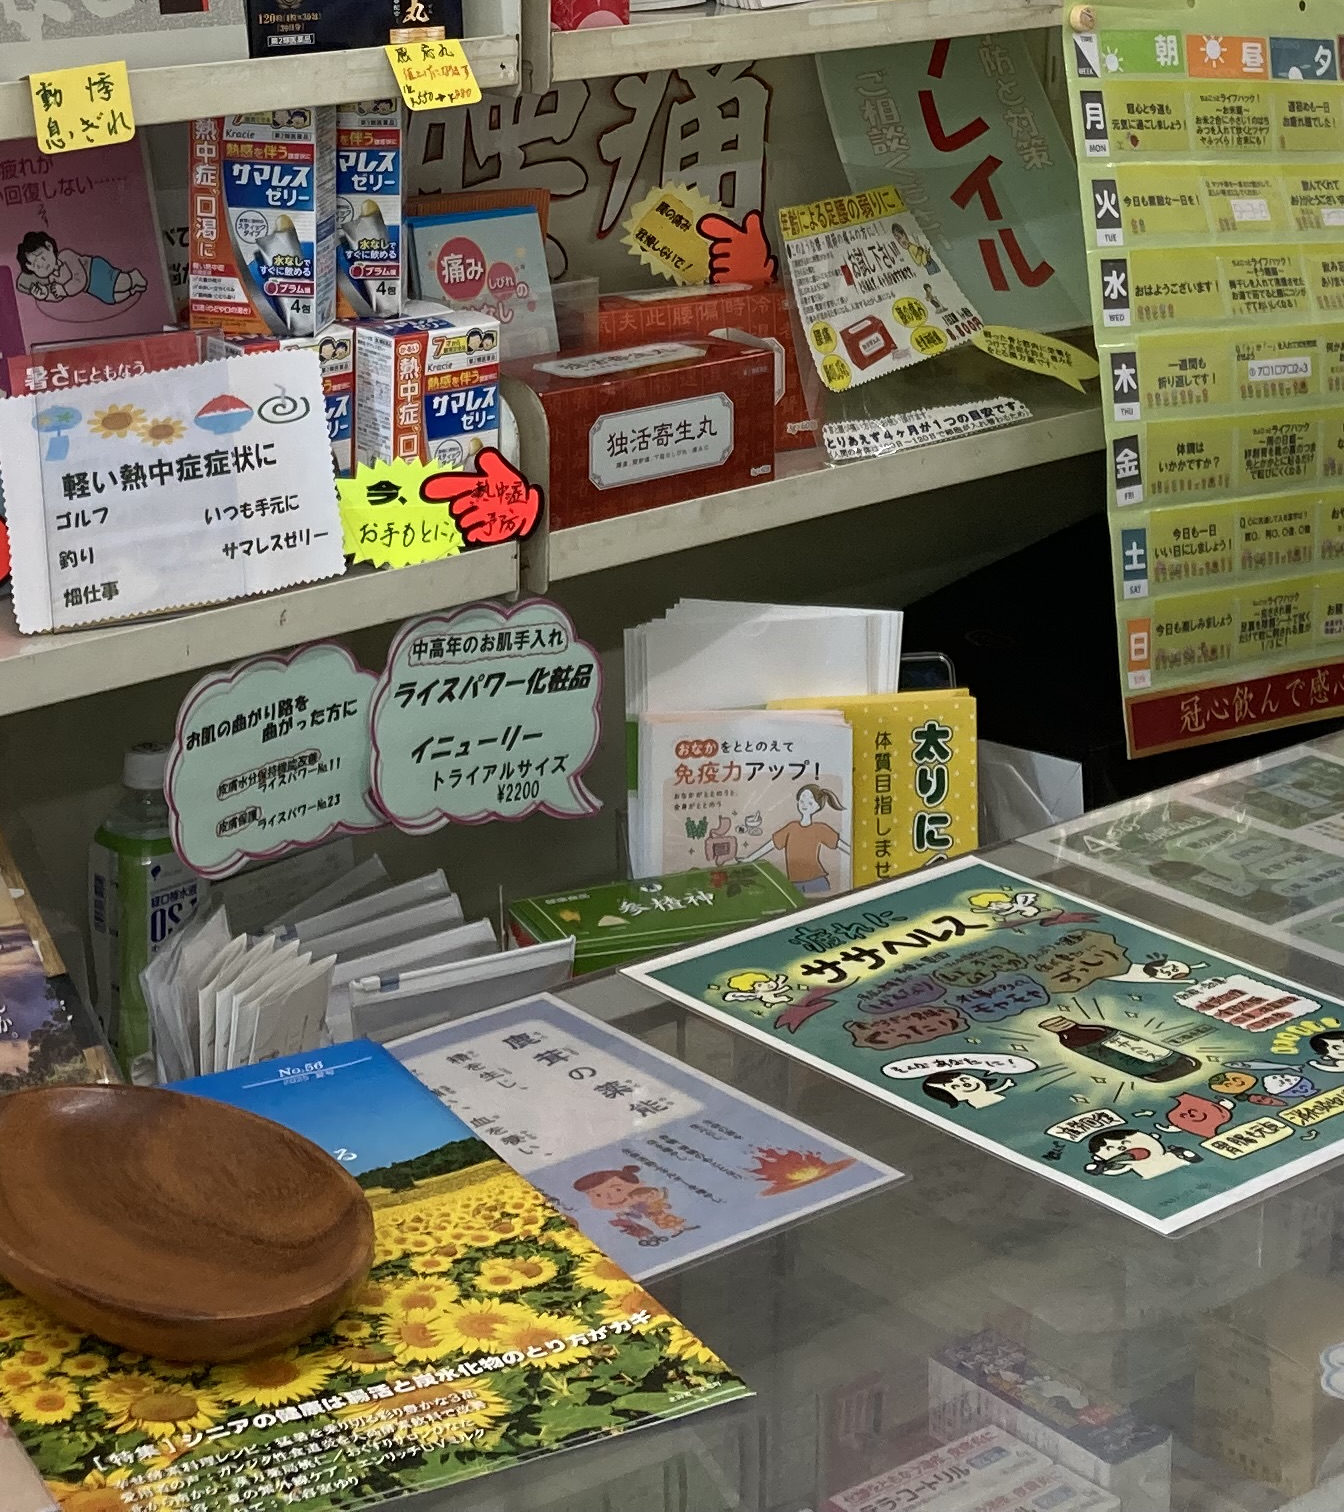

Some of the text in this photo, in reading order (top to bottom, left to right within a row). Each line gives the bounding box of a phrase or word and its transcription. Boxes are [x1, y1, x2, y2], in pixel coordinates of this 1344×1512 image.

[1154, 34, 1180, 67] 朝
[1242, 41, 1265, 73] 昼
[1315, 44, 1333, 77] 夕
[1086, 102, 1105, 130] 月
[226, 129, 256, 139] Kracie
[1088, 144, 1106, 154] MON
[232, 164, 310, 187] サマレス
[351, 173, 395, 191] ゼリー
[265, 190, 310, 206] ゼリー
[1095, 190, 1120, 220] 火
[274, 256, 311, 267] 水なしで
[345, 249, 396, 260] すぐに飲める
[442, 254, 484, 283] 痛み
[260, 266, 311, 277] すぐに飲める
[1103, 271, 1128, 300] 水
[376, 283, 396, 296] 4包
[1135, 282, 1220, 295] おはようございます!
[291, 299, 310, 314] 4包
[428, 362, 452, 372] Kracie
[1114, 363, 1136, 394] 木
[1168, 358, 1207, 371] 一週間も
[433, 386, 496, 416] サマレス
[461, 413, 495, 431] ゼリー
[607, 415, 718, 457] 独活寄生丸
[1176, 441, 1204, 455] 体調は
[62, 443, 277, 497] 軽い熱中症症状に
[1115, 448, 1139, 479] 金
[56, 506, 110, 530] ゴルフ
[205, 494, 299, 524] いつも手元に
[223, 529, 328, 560] サマレスゼリー
[1172, 526, 1217, 539] 今日も一日
[59, 546, 95, 568] 釣り
[1124, 542, 1146, 570] 土
[63, 582, 119, 608] 畑仕事
[412, 628, 564, 661] 中高年のお肌手入れ
[1129, 632, 1147, 661] 日
[394, 663, 594, 709] ライスパワー化粧品
[187, 695, 309, 750] お肌の曲がり路を
[262, 699, 357, 743] 曲がった方に
[411, 725, 544, 763] イニューリー
[677, 740, 794, 757] おなかをととのえて
[434, 754, 567, 791] トライアルサイズ
[674, 760, 820, 786] 免疫力アップ!
[497, 781, 540, 804] ¥2200
[801, 916, 989, 982] ササヘルス
